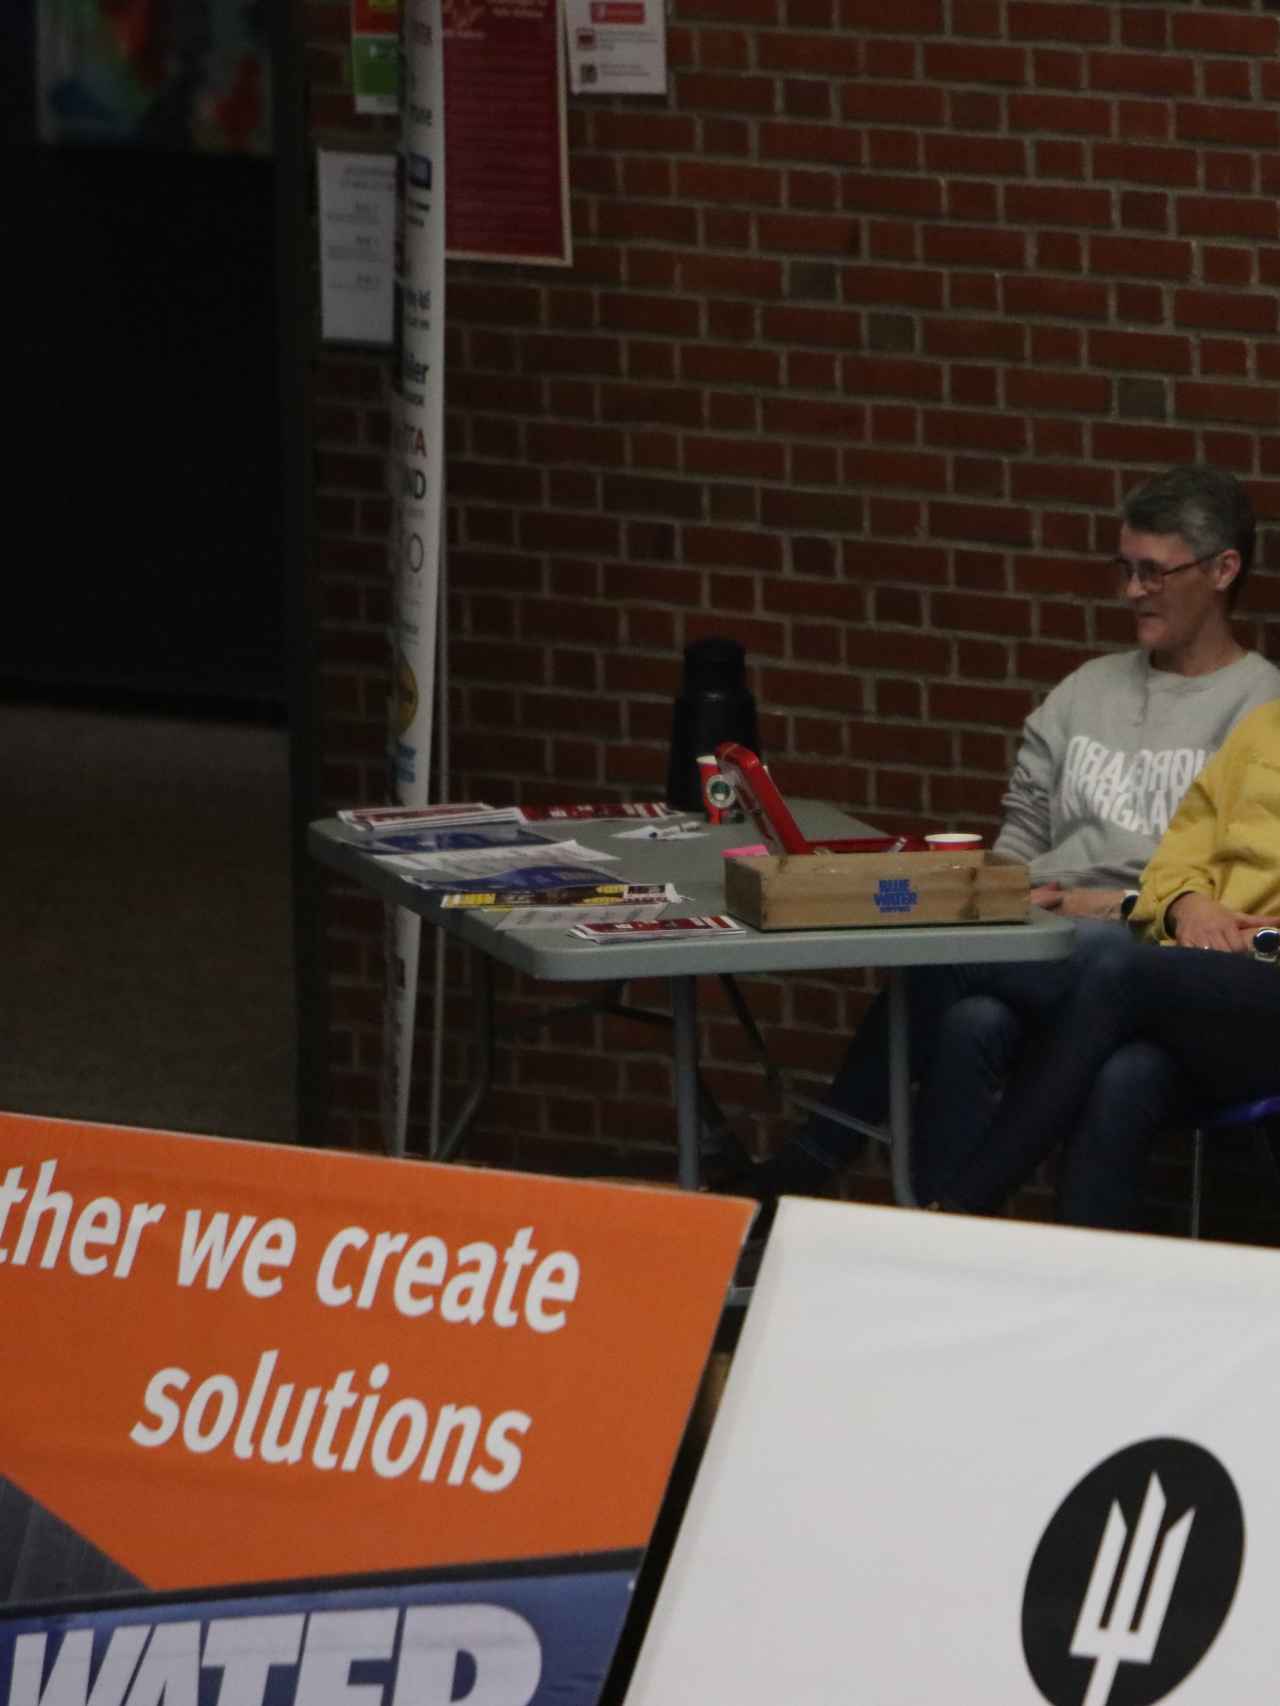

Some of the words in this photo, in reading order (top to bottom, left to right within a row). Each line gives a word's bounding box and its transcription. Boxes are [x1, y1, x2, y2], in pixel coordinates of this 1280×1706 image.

[176, 1208, 297, 1299] we
[315, 1226, 581, 1334] create
[130, 1350, 532, 1493] solutions
